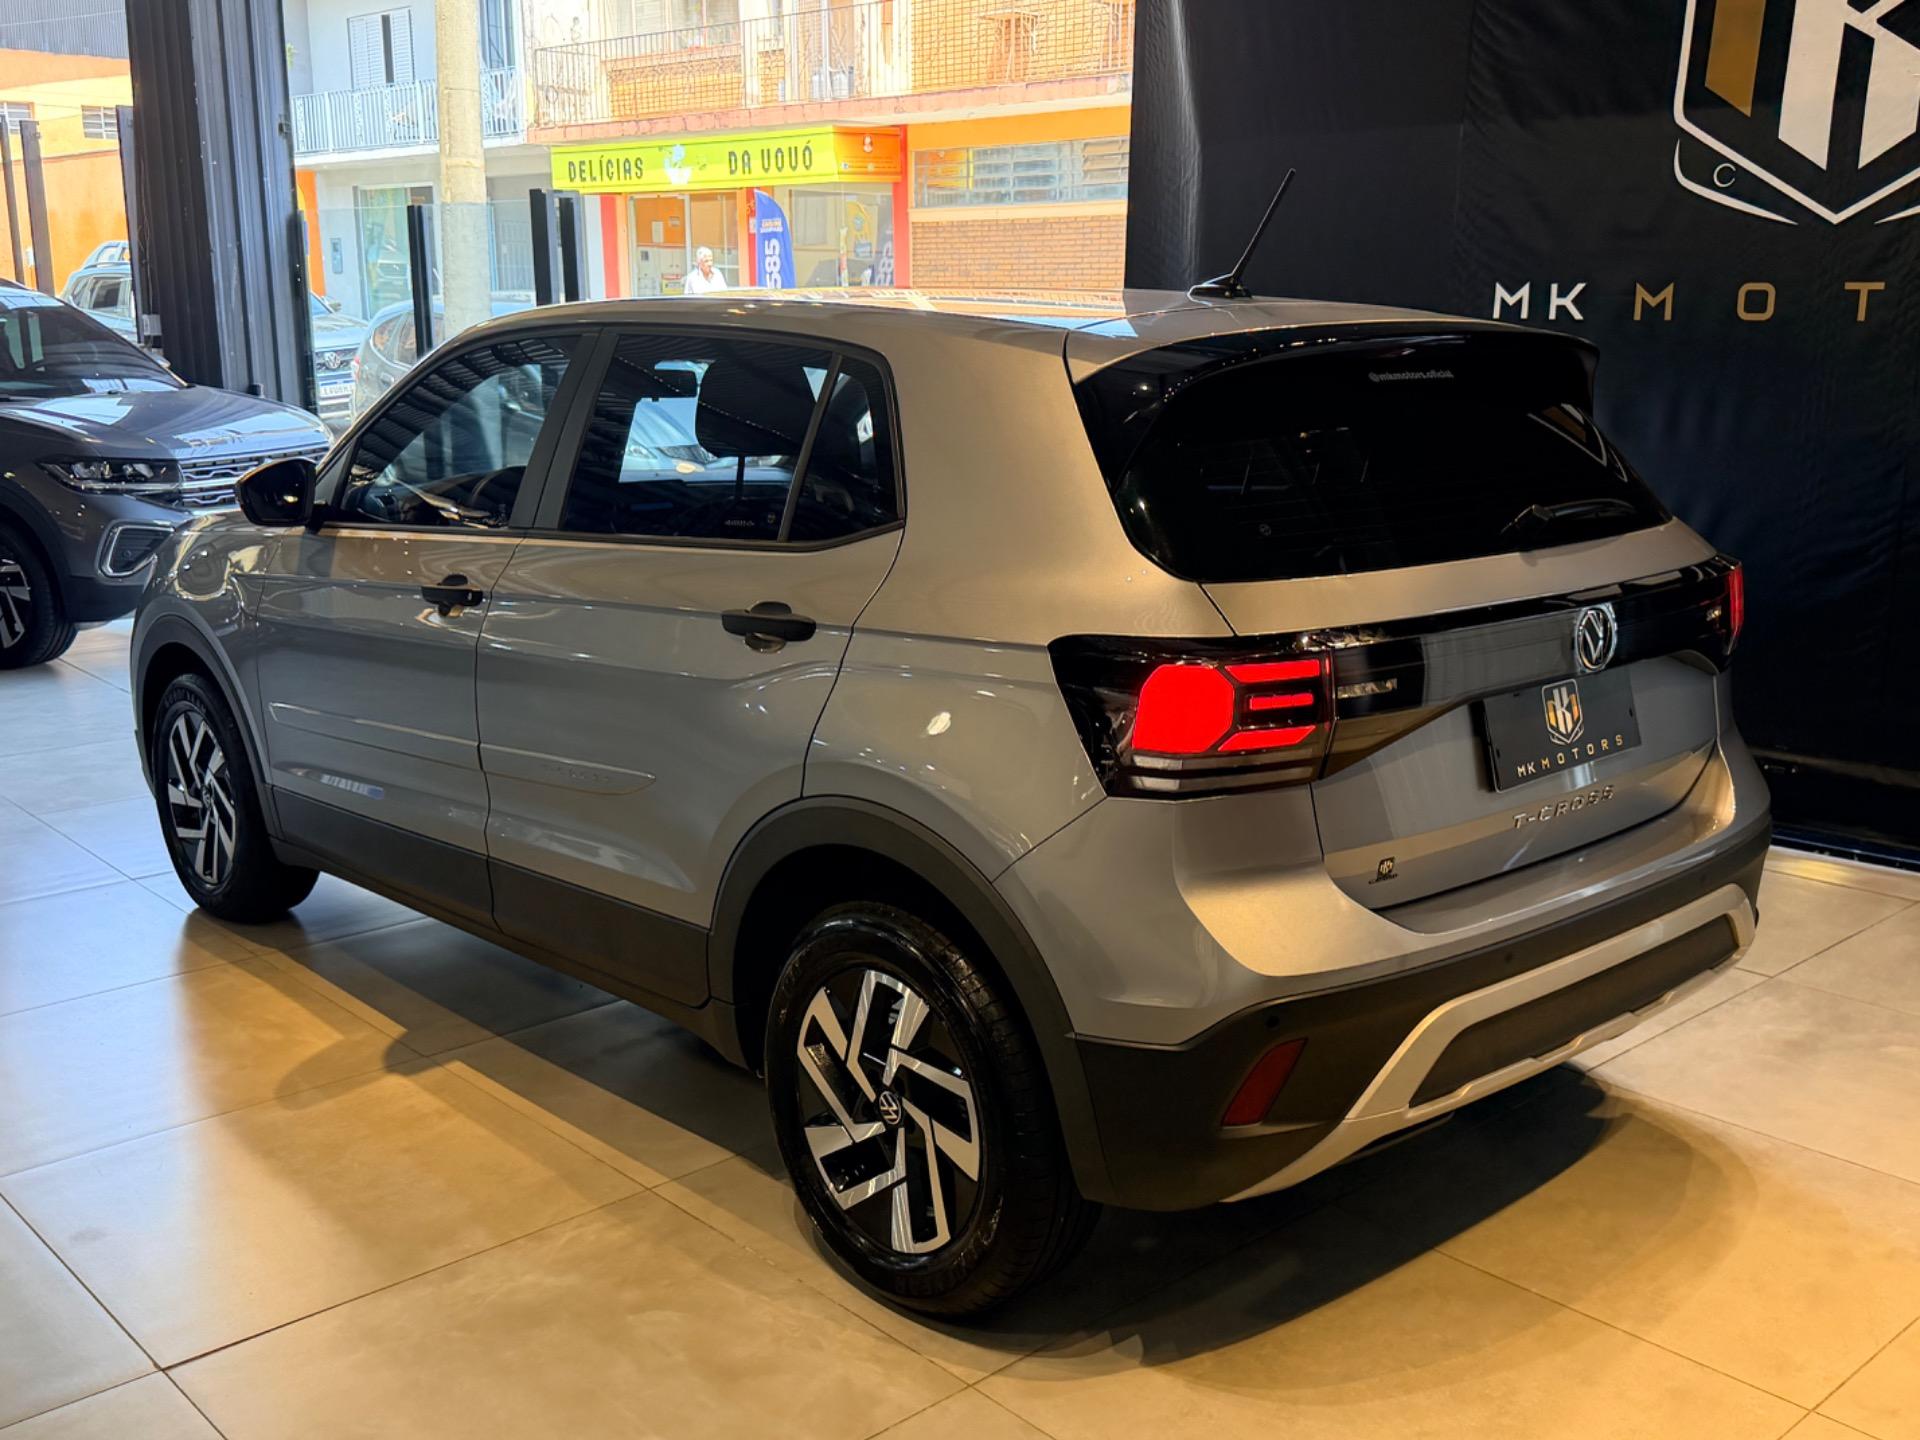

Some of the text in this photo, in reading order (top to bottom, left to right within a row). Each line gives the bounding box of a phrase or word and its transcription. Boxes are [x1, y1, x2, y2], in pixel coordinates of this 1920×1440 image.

[567, 155, 644, 183] DELÍCIAS
[728, 150, 752, 176] DA
[1492, 281, 1588, 321] MK
[1516, 734, 1625, 778] MK MOTORS
[1512, 784, 1616, 830] T-CROSS
